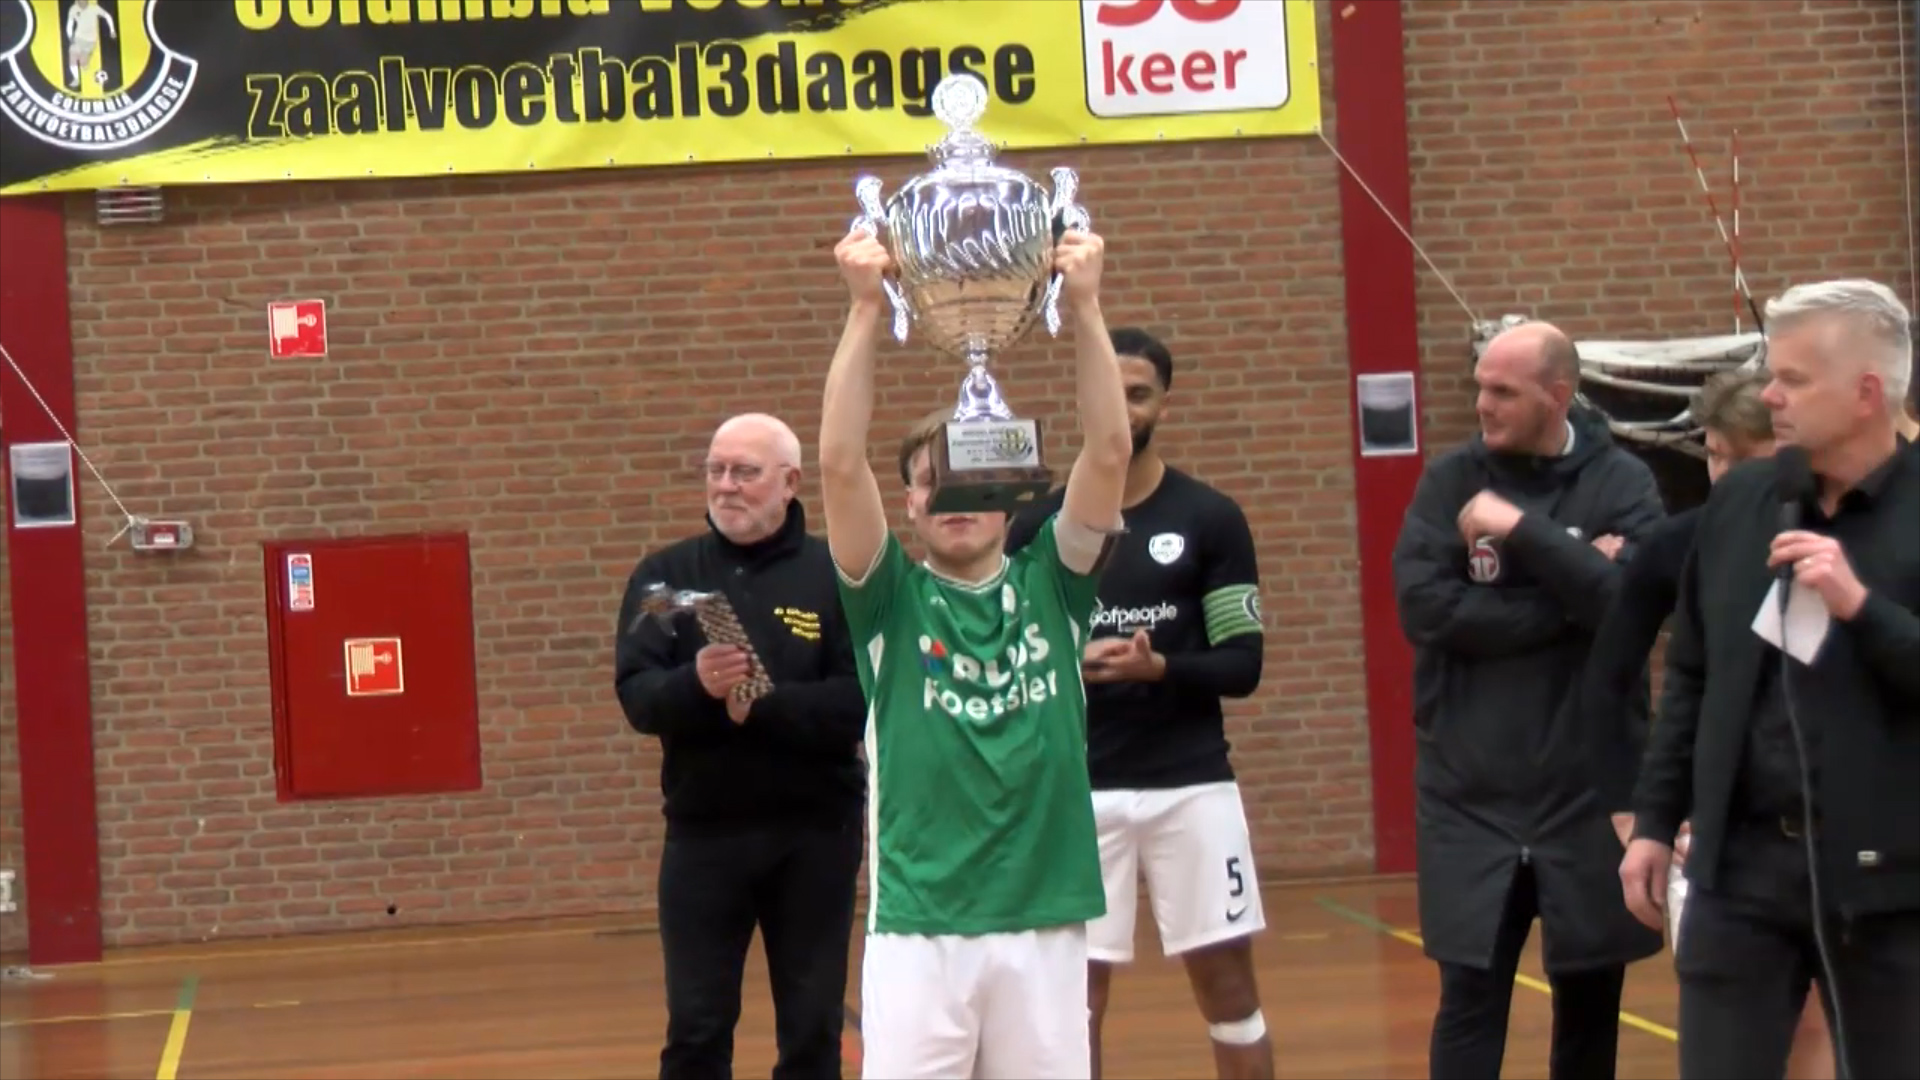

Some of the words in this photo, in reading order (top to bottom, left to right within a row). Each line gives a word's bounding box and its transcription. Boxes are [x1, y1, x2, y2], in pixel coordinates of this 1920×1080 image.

[246, 38, 1036, 140] zaalvoetbal3daagse
[1102, 40, 1247, 95] keer
[1226, 856, 1243, 897] 5
